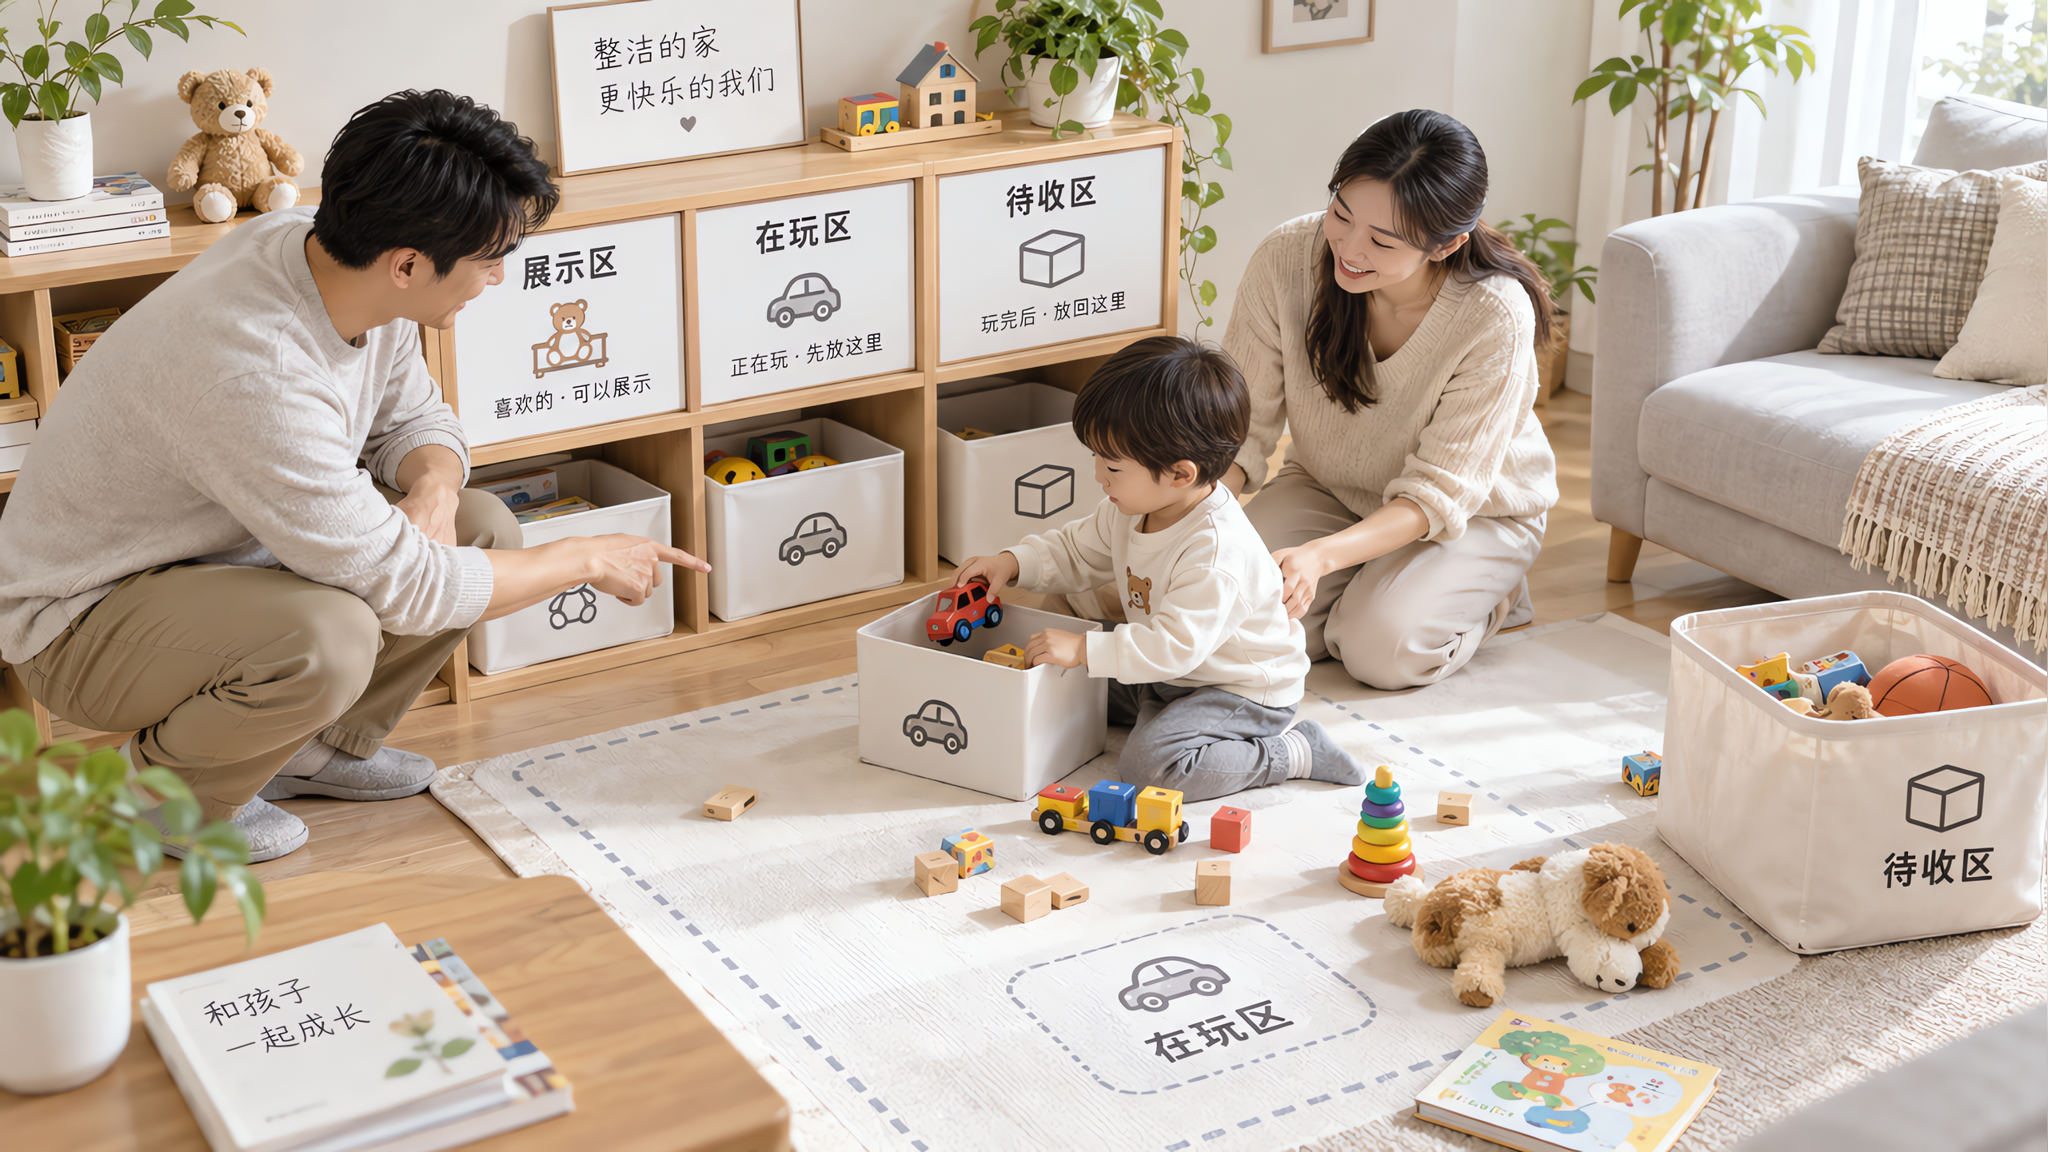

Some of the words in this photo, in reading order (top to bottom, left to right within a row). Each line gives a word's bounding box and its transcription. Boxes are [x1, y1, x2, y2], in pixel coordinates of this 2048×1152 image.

[594, 24, 720, 71] 整洁的家
[599, 66, 775, 116] 更快乐的我们
[1006, 175, 1097, 219] 待收区
[755, 209, 852, 255] 在玩区
[522, 245, 618, 291] 展示区
[1883, 847, 1995, 889] 待收区
[203, 977, 311, 1027] 和孩子
[226, 1002, 371, 1053] 一起成长
[1144, 999, 1295, 1064] 在玩区
